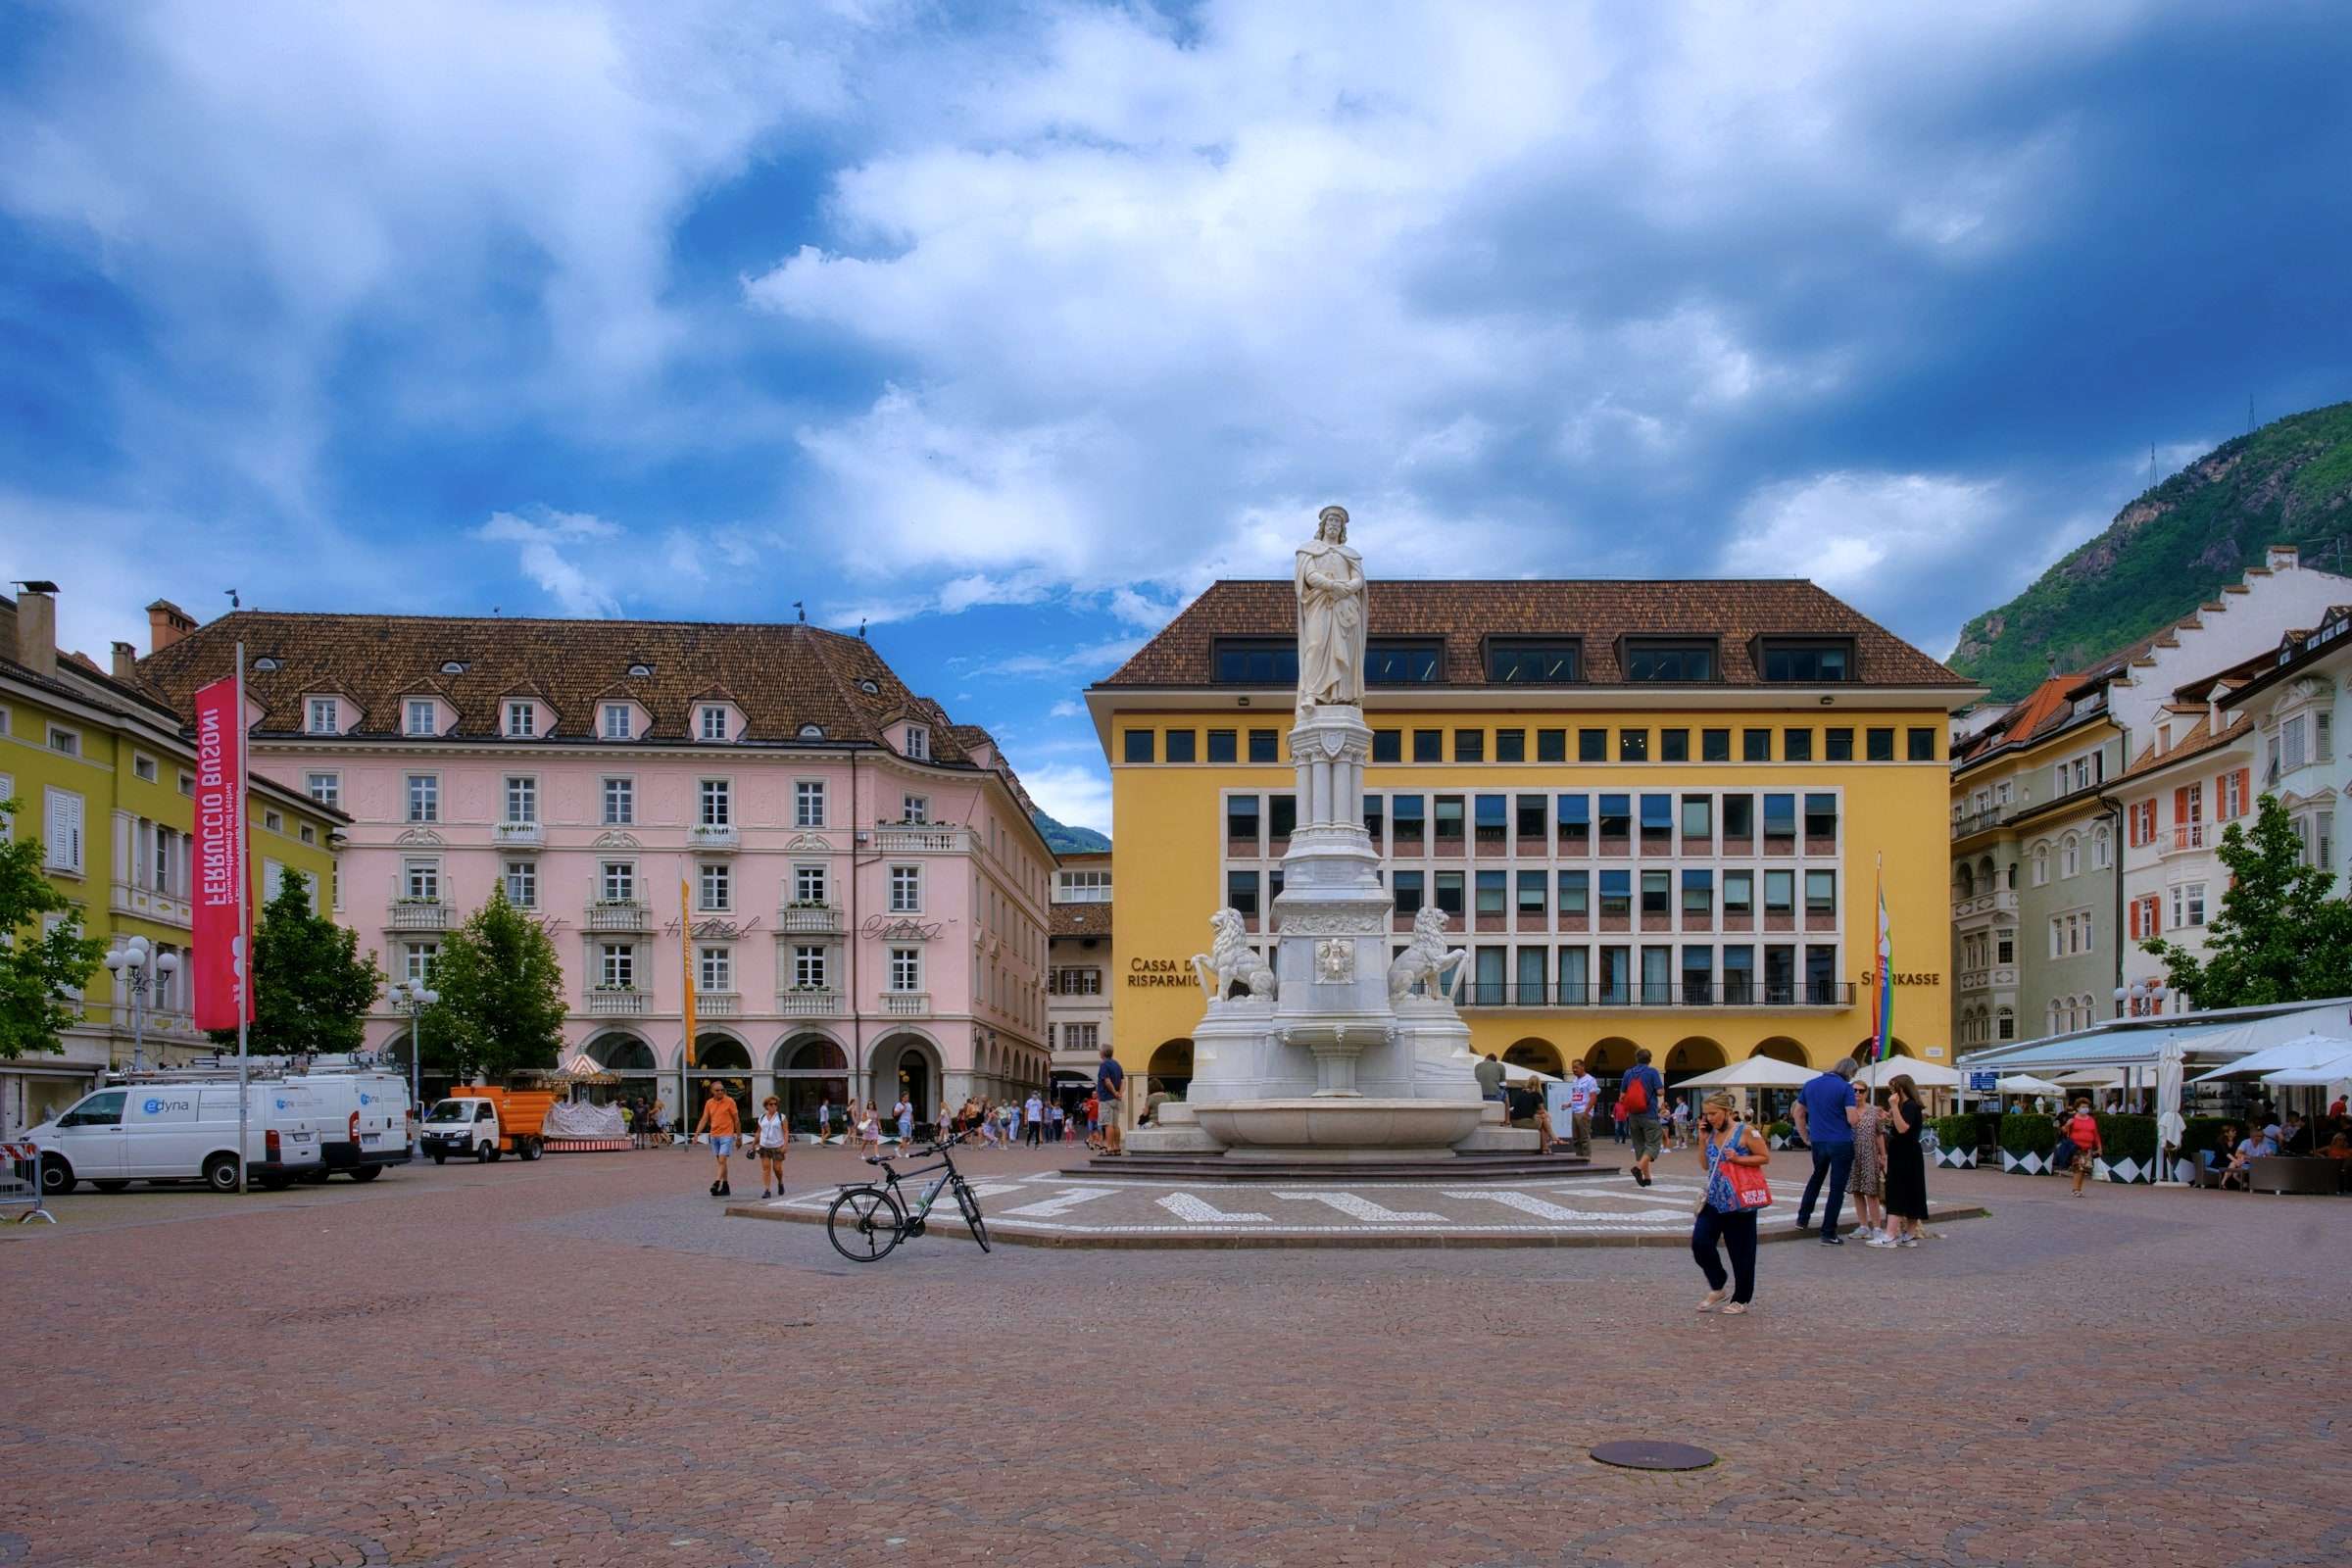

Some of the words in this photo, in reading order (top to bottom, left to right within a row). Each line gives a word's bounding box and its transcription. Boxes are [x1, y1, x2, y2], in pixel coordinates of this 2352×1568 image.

[1131, 956, 1177, 972] CASSA
[1861, 971, 1939, 986] SRKASSE
[145, 1099, 189, 1113] edyna
